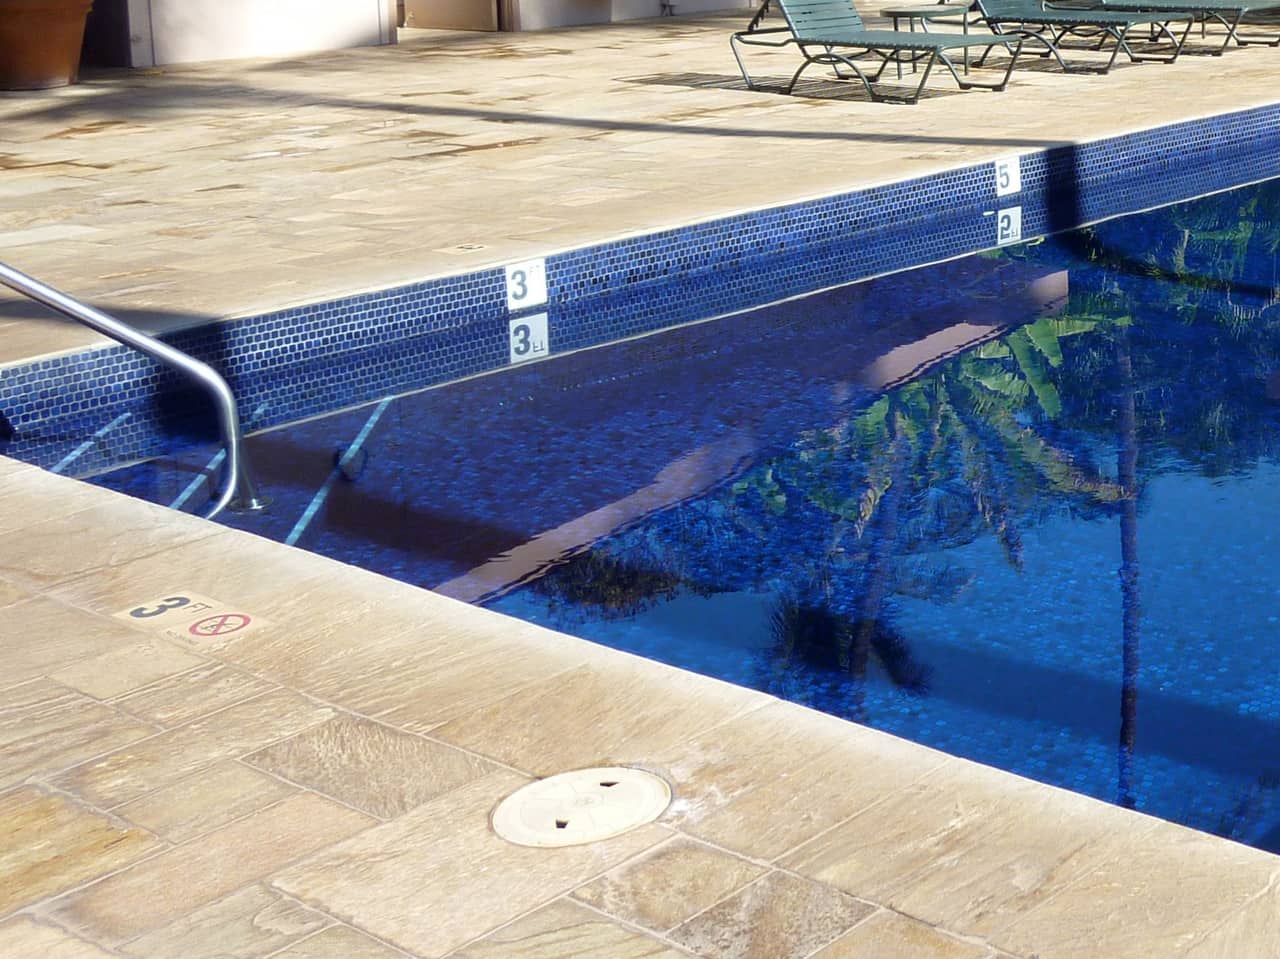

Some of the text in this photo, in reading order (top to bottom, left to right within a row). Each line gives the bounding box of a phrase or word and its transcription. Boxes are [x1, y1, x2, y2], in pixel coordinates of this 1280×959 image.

[999, 164, 1010, 189] 5
[511, 269, 528, 301] 3
[129, 596, 213, 618] 3 FT
